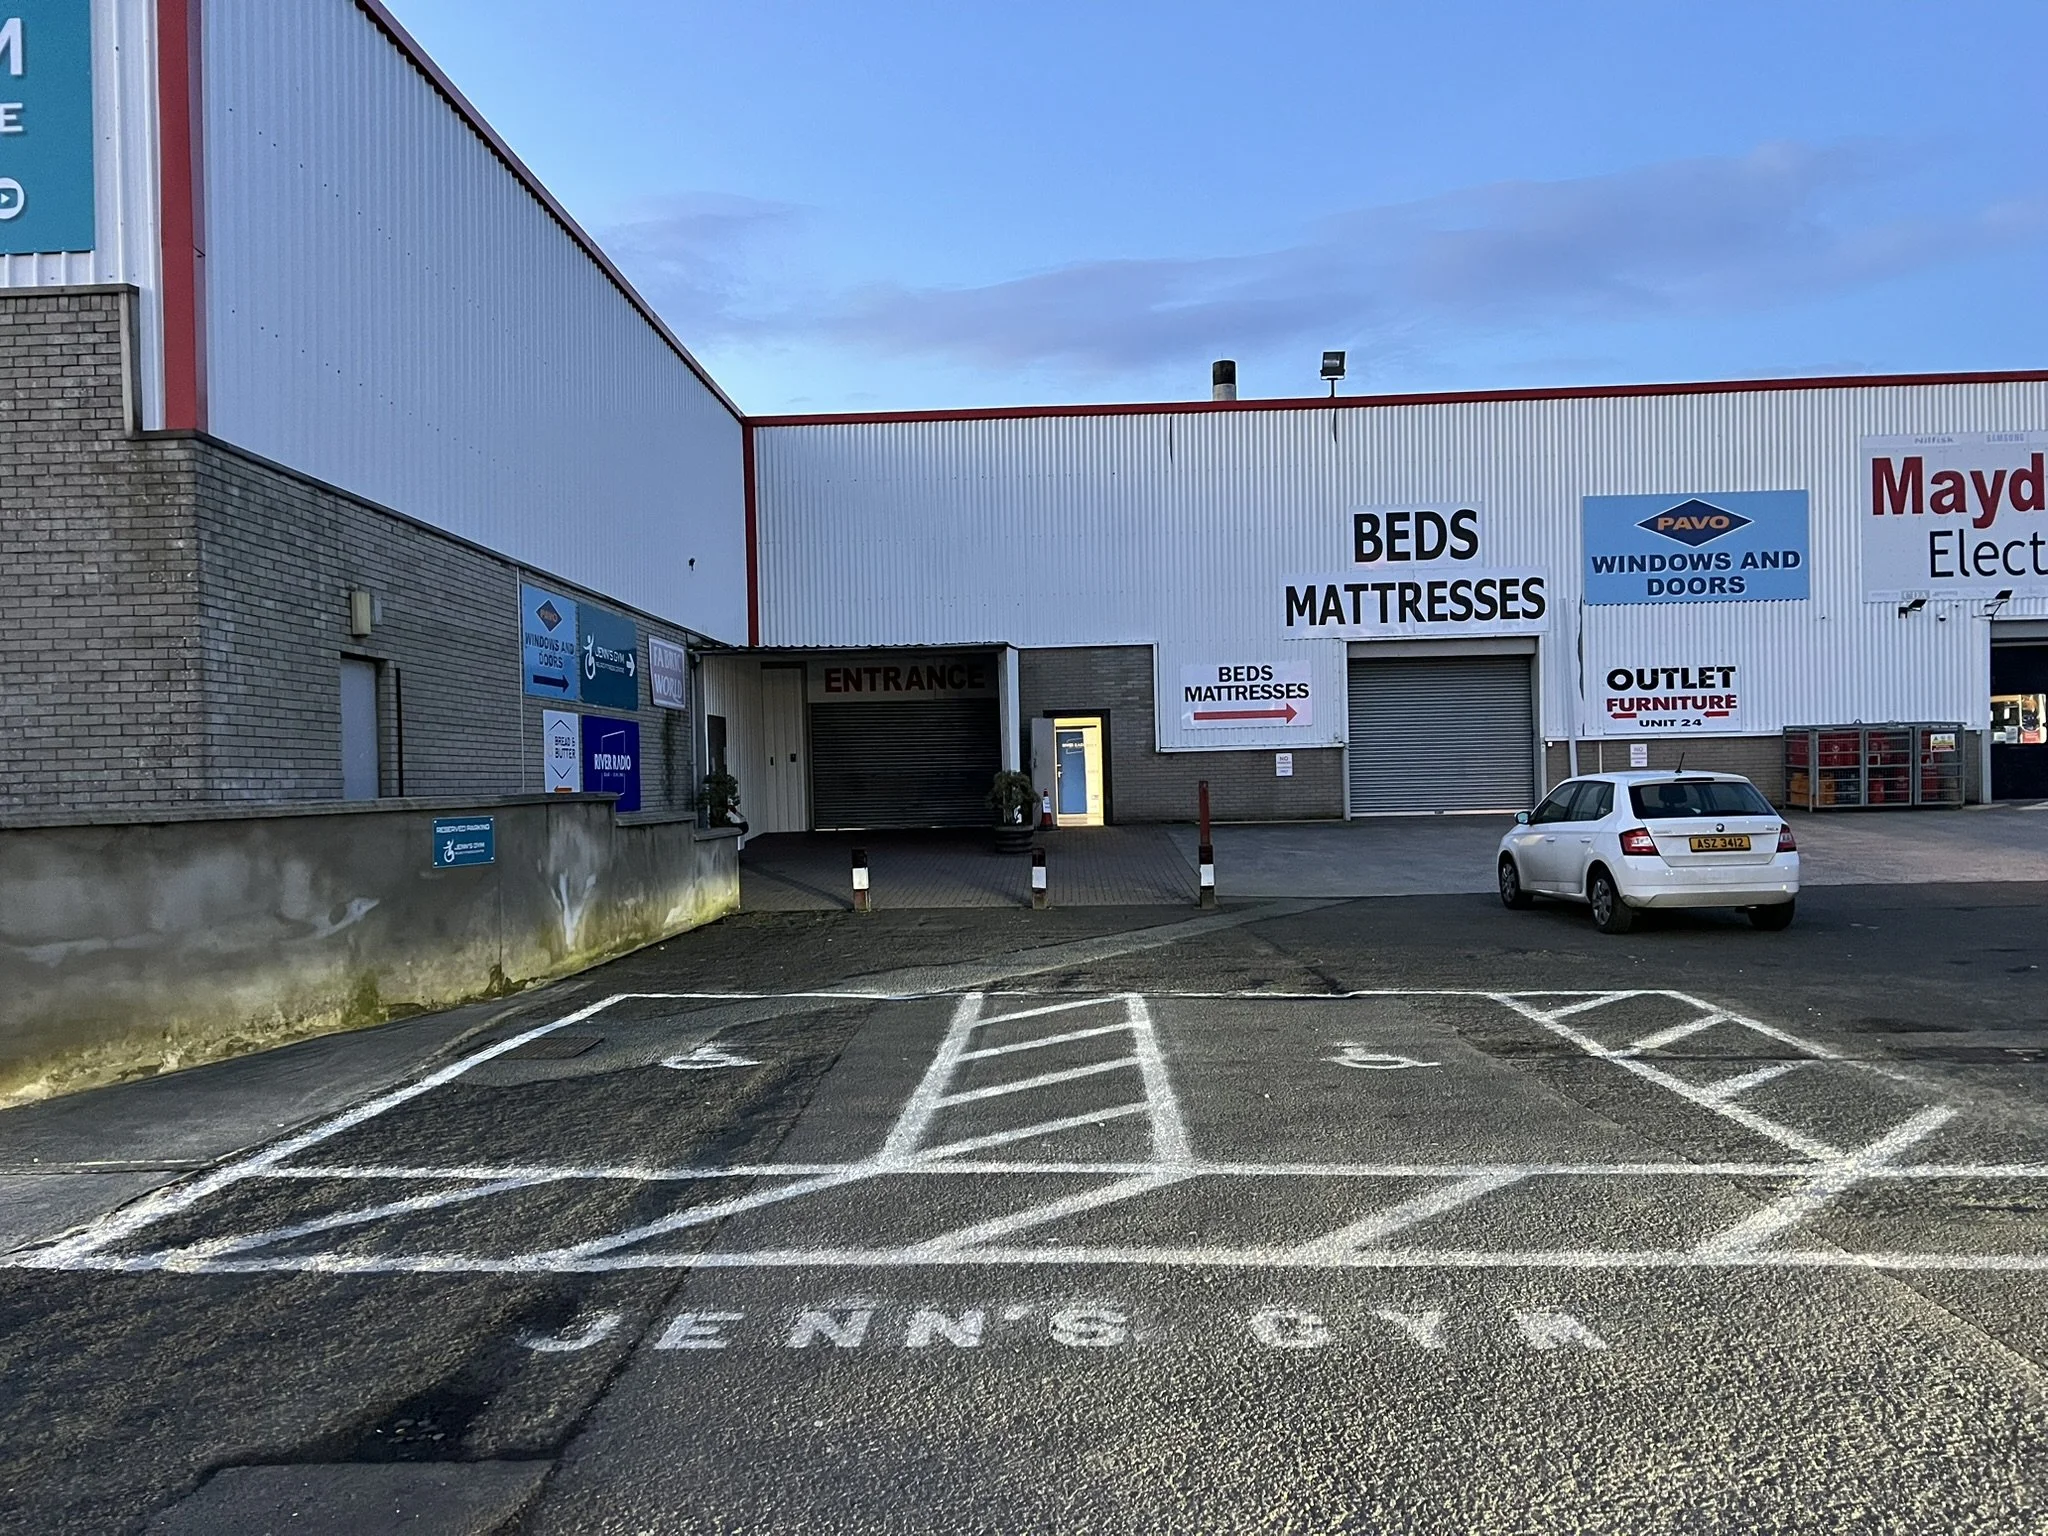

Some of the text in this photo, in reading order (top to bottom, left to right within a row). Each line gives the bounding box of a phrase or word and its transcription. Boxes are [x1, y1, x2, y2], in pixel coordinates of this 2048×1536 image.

[1986, 433, 2025, 443] SAMSUNG
[1871, 452, 2046, 529] Mayd
[1657, 515, 1730, 531] PAVO
[1353, 508, 1479, 563] BEDS
[1591, 550, 1801, 574] WINDOWS AND
[1929, 528, 2048, 578] Elect
[1647, 576, 1746, 596] DOORS
[1285, 577, 1546, 627] MATTRESSES
[525, 632, 575, 656] WINDOWS AND
[539, 652, 563, 668] DOORS
[653, 646, 682, 673] FABRIC
[824, 665, 985, 693] ENTRANCE
[1219, 665, 1274, 683] BEDS
[1606, 666, 1737, 691] OUTLET
[654, 673, 683, 702] WORLD
[1185, 683, 1310, 703] MATTRESSES
[1607, 694, 1738, 713] FURNITURE
[1639, 718, 1703, 728] UNIT 24
[554, 735, 571, 747] BREAD
[555, 747, 576, 760] BUTTER
[594, 753, 631, 771] RIVER RADIO
[1697, 837, 1745, 849] ASZ 3412
[517, 1304, 1127, 1352] JENN'S
